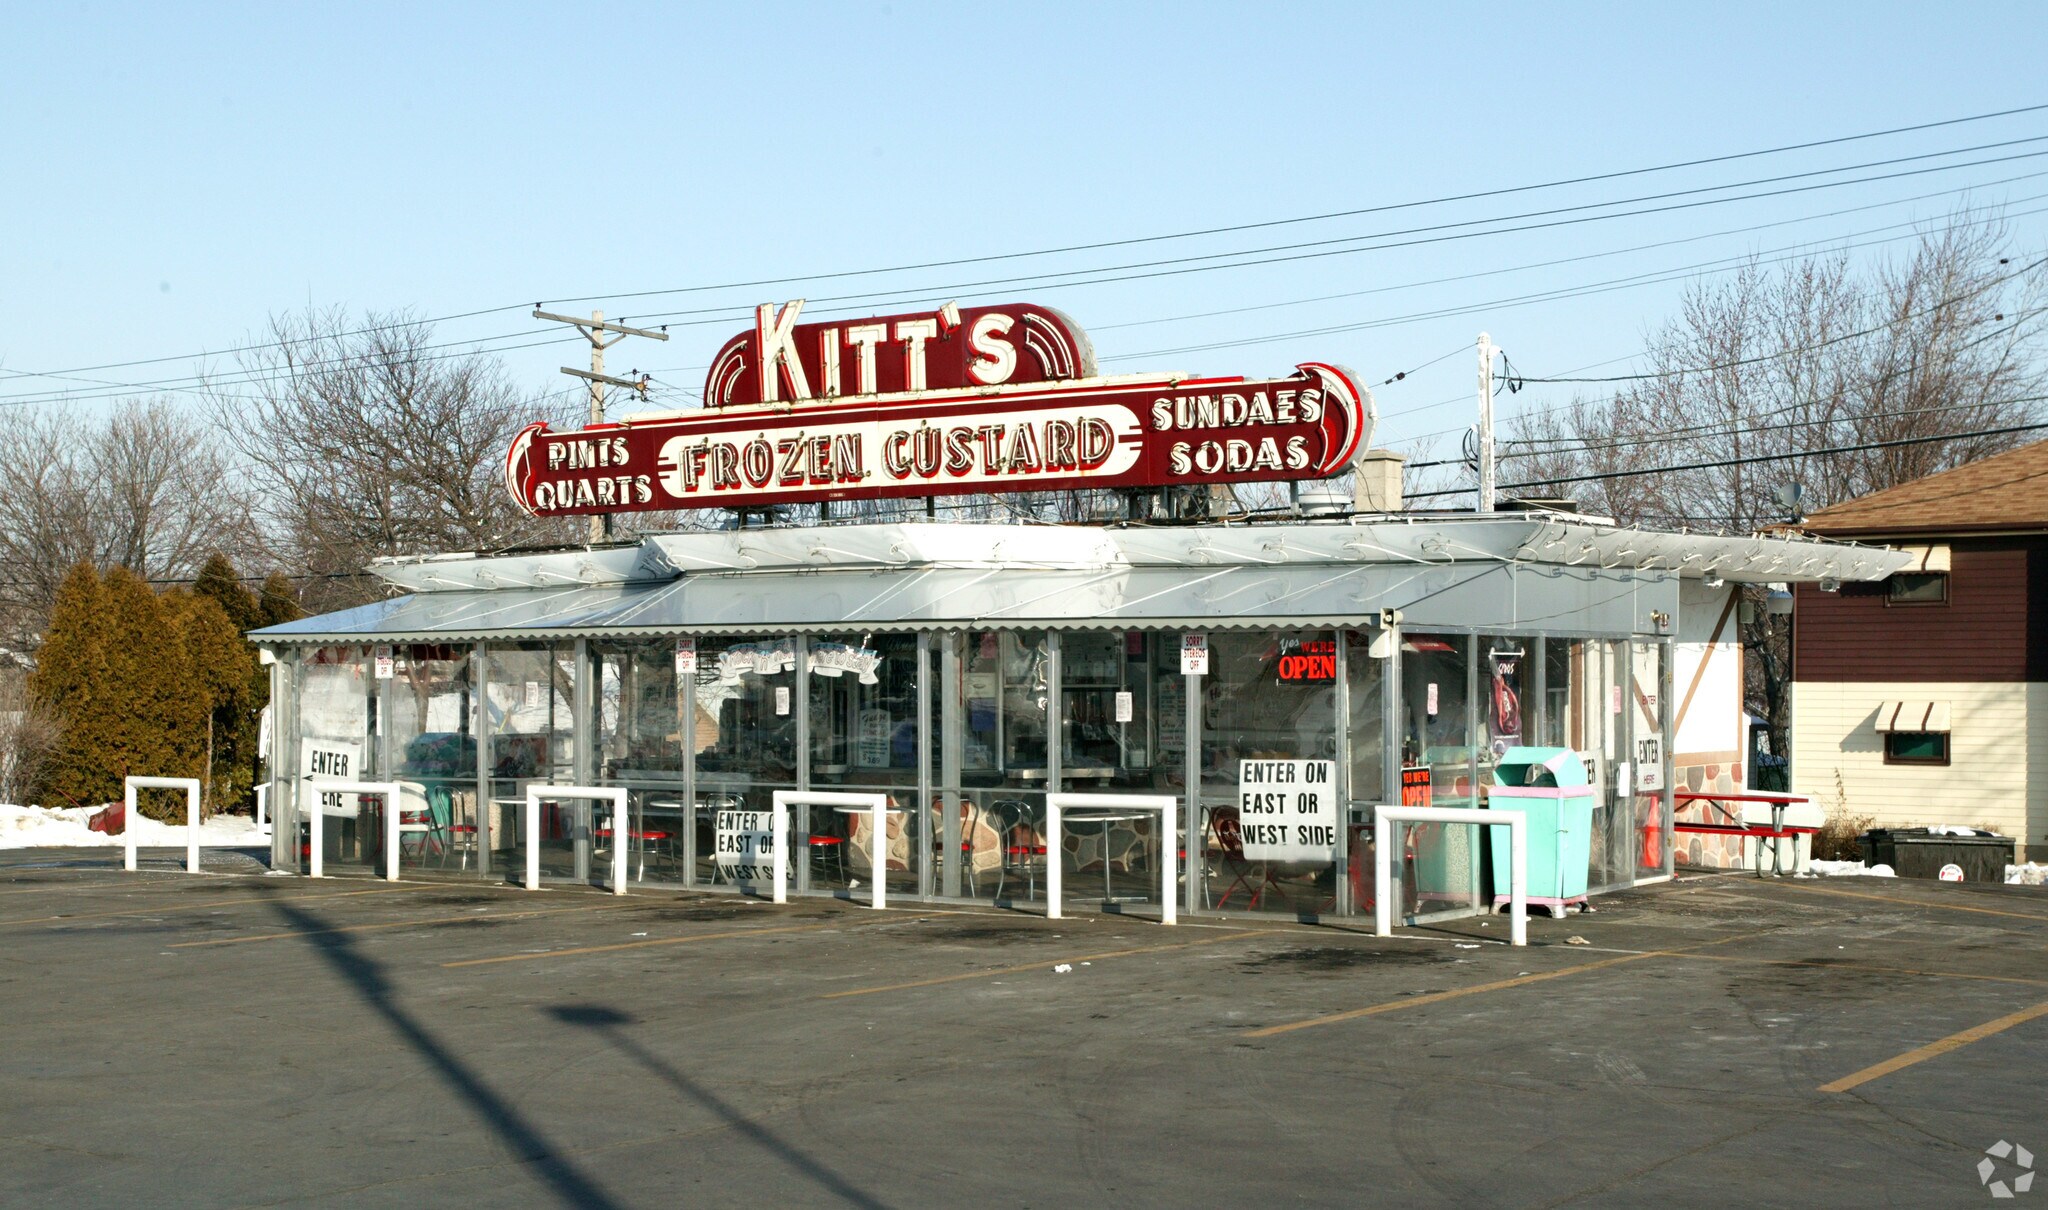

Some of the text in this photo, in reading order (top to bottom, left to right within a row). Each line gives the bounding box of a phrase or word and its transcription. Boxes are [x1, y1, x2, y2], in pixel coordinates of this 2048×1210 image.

[756, 298, 1017, 402] KITT'S
[1151, 388, 1322, 431] SUNDAES
[548, 437, 630, 471] PINTS
[680, 417, 1115, 492] FROZEN CUSTARD
[1169, 435, 1310, 476] SODAS
[534, 474, 652, 511] QUARTS
[1185, 635, 1204, 647] SORRY
[1183, 647, 1206, 658] STEREOS
[1190, 660, 1200, 670] OFF
[1279, 655, 1336, 679] OPEN
[1638, 739, 1659, 764] ENTER
[311, 750, 349, 777] ENTER
[1244, 762, 1327, 783] ENTER ON
[1242, 793, 1319, 814] EAST OR
[1402, 785, 1431, 807] OPEN
[718, 812, 758, 831] ENTER
[719, 834, 752, 853] EAST
[1242, 825, 1335, 846] WEST SIDE
[721, 864, 761, 880] WEST
